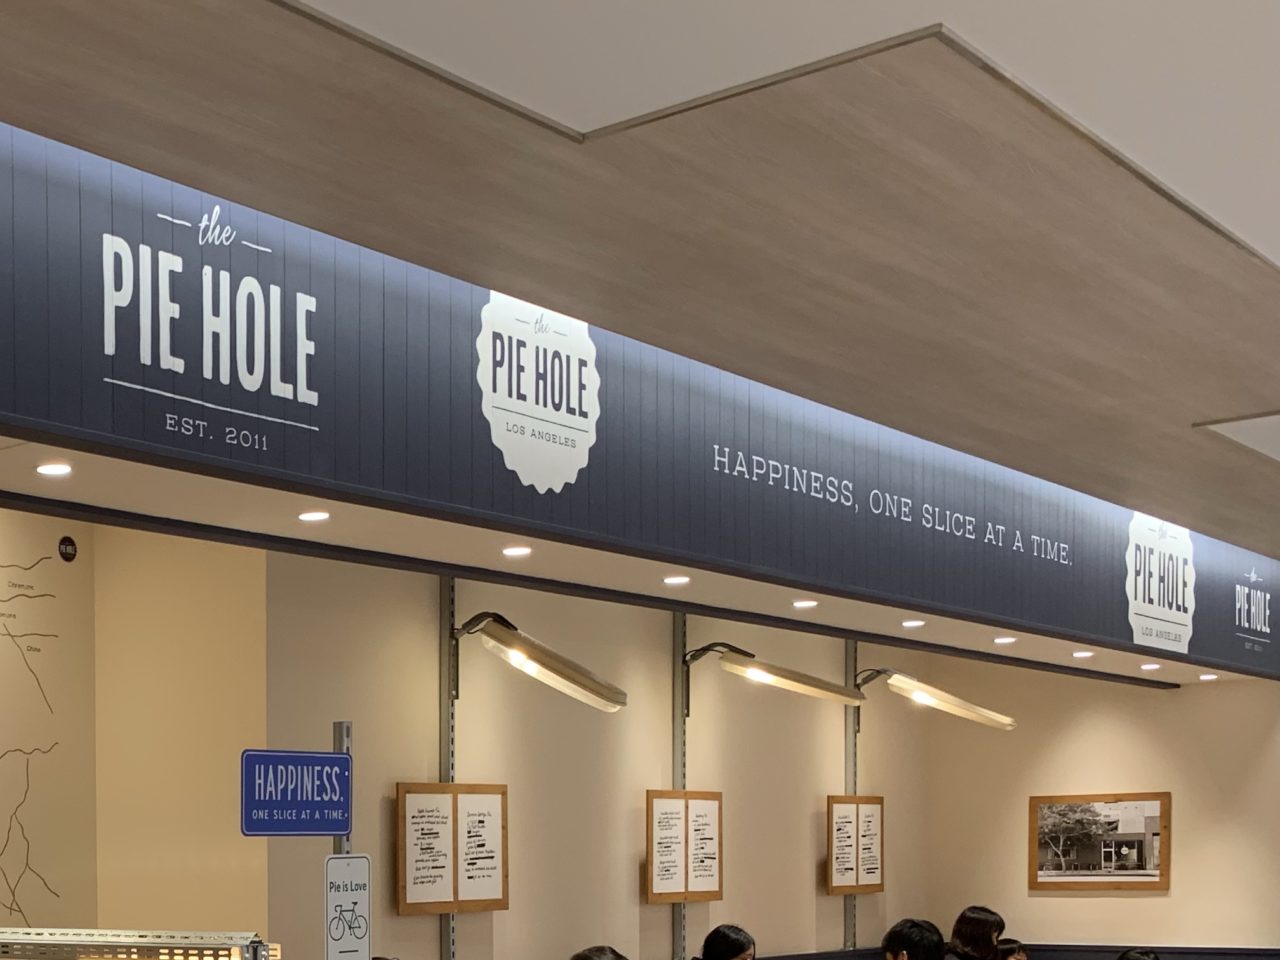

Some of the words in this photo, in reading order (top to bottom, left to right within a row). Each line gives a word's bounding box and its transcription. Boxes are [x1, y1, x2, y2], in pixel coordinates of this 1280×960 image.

[198, 205, 236, 245] the
[103, 233, 185, 374] PIE
[202, 265, 319, 406] HOLE
[492, 331, 527, 402] PIE
[535, 345, 588, 419] HOLE
[165, 414, 213, 439] EST.
[225, 427, 267, 450] 2011
[506, 422, 526, 435] LOS
[530, 428, 577, 449] ANGELES
[713, 445, 859, 513] HAPPINESS,
[869, 489, 912, 522] ONE
[922, 503, 976, 539] SLICE
[984, 521, 1006, 547] AT
[1012, 530, 1024, 552] A
[1031, 535, 1073, 566] TIME.
[1135, 543, 1154, 605] PIE
[1158, 551, 1188, 614] HOLE
[1235, 584, 1249, 628] PIE
[1251, 589, 1271, 634] HOLE
[255, 764, 344, 802] HAPPINESS.
[252, 810, 269, 820] ONE
[273, 810, 297, 820] SLICE
[301, 810, 311, 820] AT
[314, 810, 320, 820] A
[324, 810, 346, 821] TIME.
[329, 881, 342, 893] Pie
[342, 881, 348, 893] is
[350, 880, 367, 892] Love
